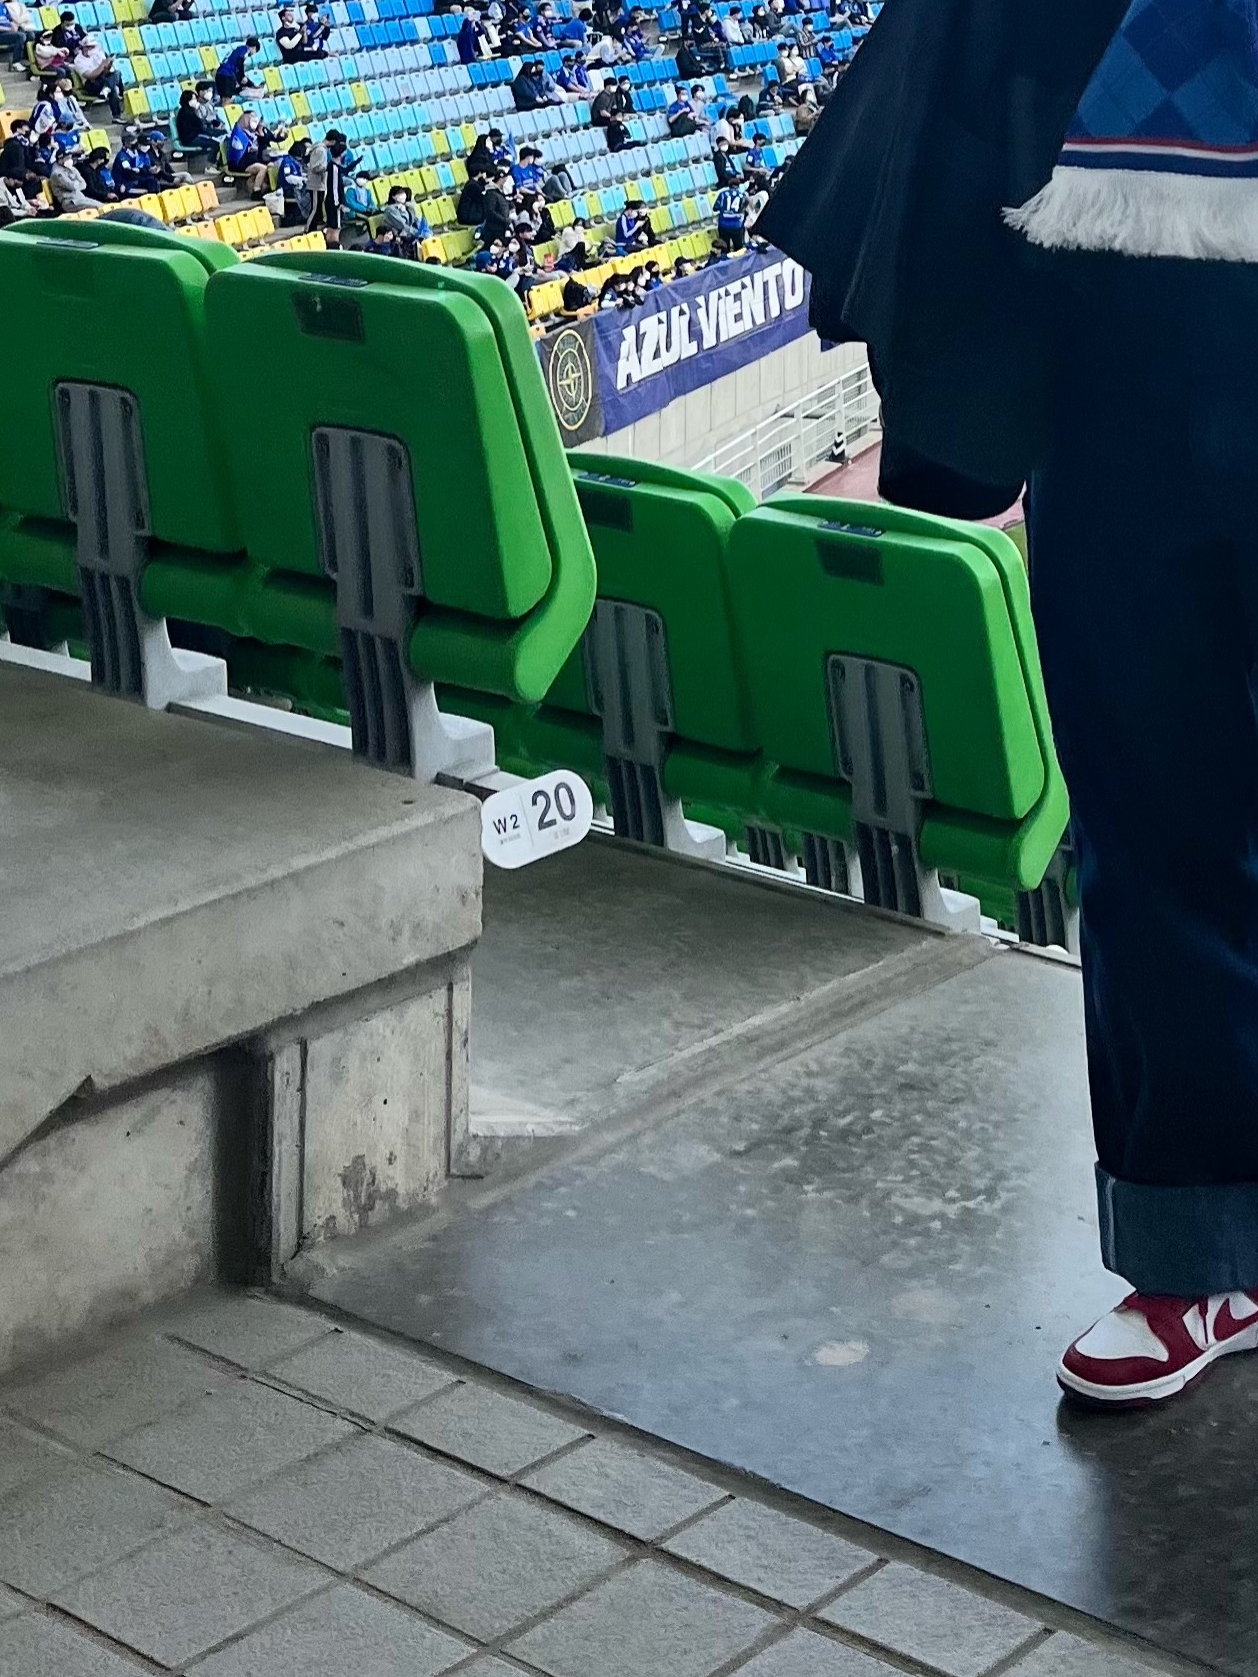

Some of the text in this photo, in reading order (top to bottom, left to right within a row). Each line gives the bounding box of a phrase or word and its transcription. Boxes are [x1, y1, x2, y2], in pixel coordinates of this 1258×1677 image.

[615, 304, 699, 391] AZUL
[694, 258, 806, 351] VIENTO
[530, 781, 577, 832] 20
